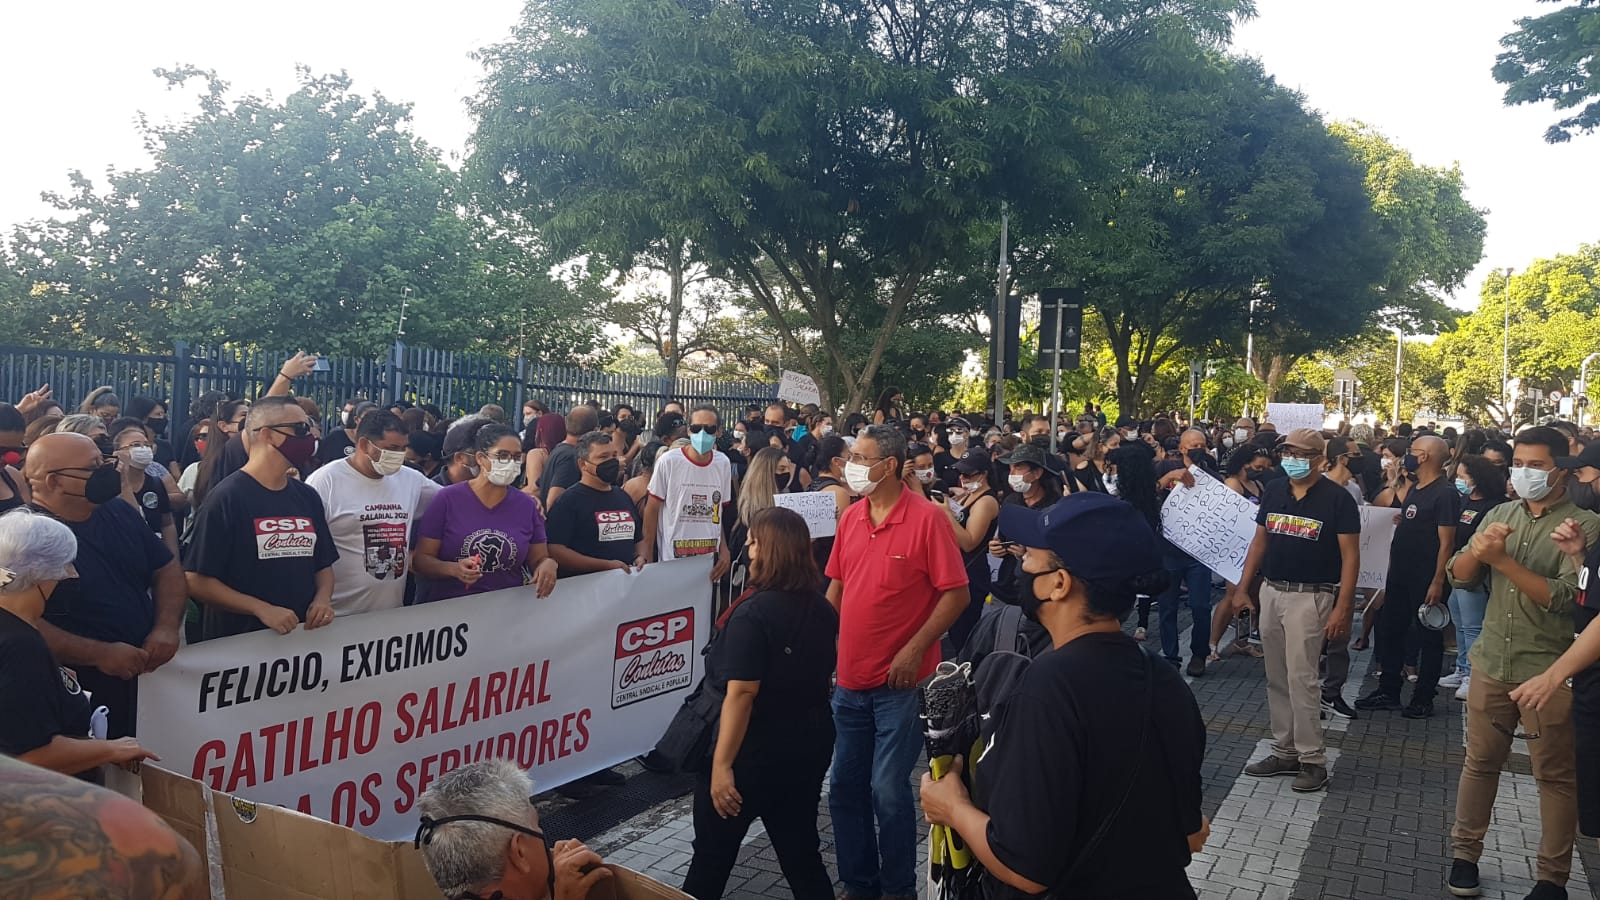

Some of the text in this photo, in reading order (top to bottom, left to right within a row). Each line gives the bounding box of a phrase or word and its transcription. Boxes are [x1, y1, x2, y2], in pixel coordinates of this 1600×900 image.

[360, 513, 394, 521] SALARIAL
[599, 511, 630, 522] CSP
[1169, 493, 1195, 514] QUE
[258, 518, 310, 532] CSP
[263, 533, 312, 550] Conlutas
[621, 616, 688, 652] CSP
[198, 622, 469, 713] FELICIO, EXIGIMOS
[619, 650, 686, 689] Conlutas
[616, 692, 639, 703] CENTRAL
[640, 685, 661, 697] SINDICAL
[666, 676, 689, 687] POPULAR
[191, 660, 552, 793] GATILHO SALARIAL
[331, 772, 382, 828] OS
